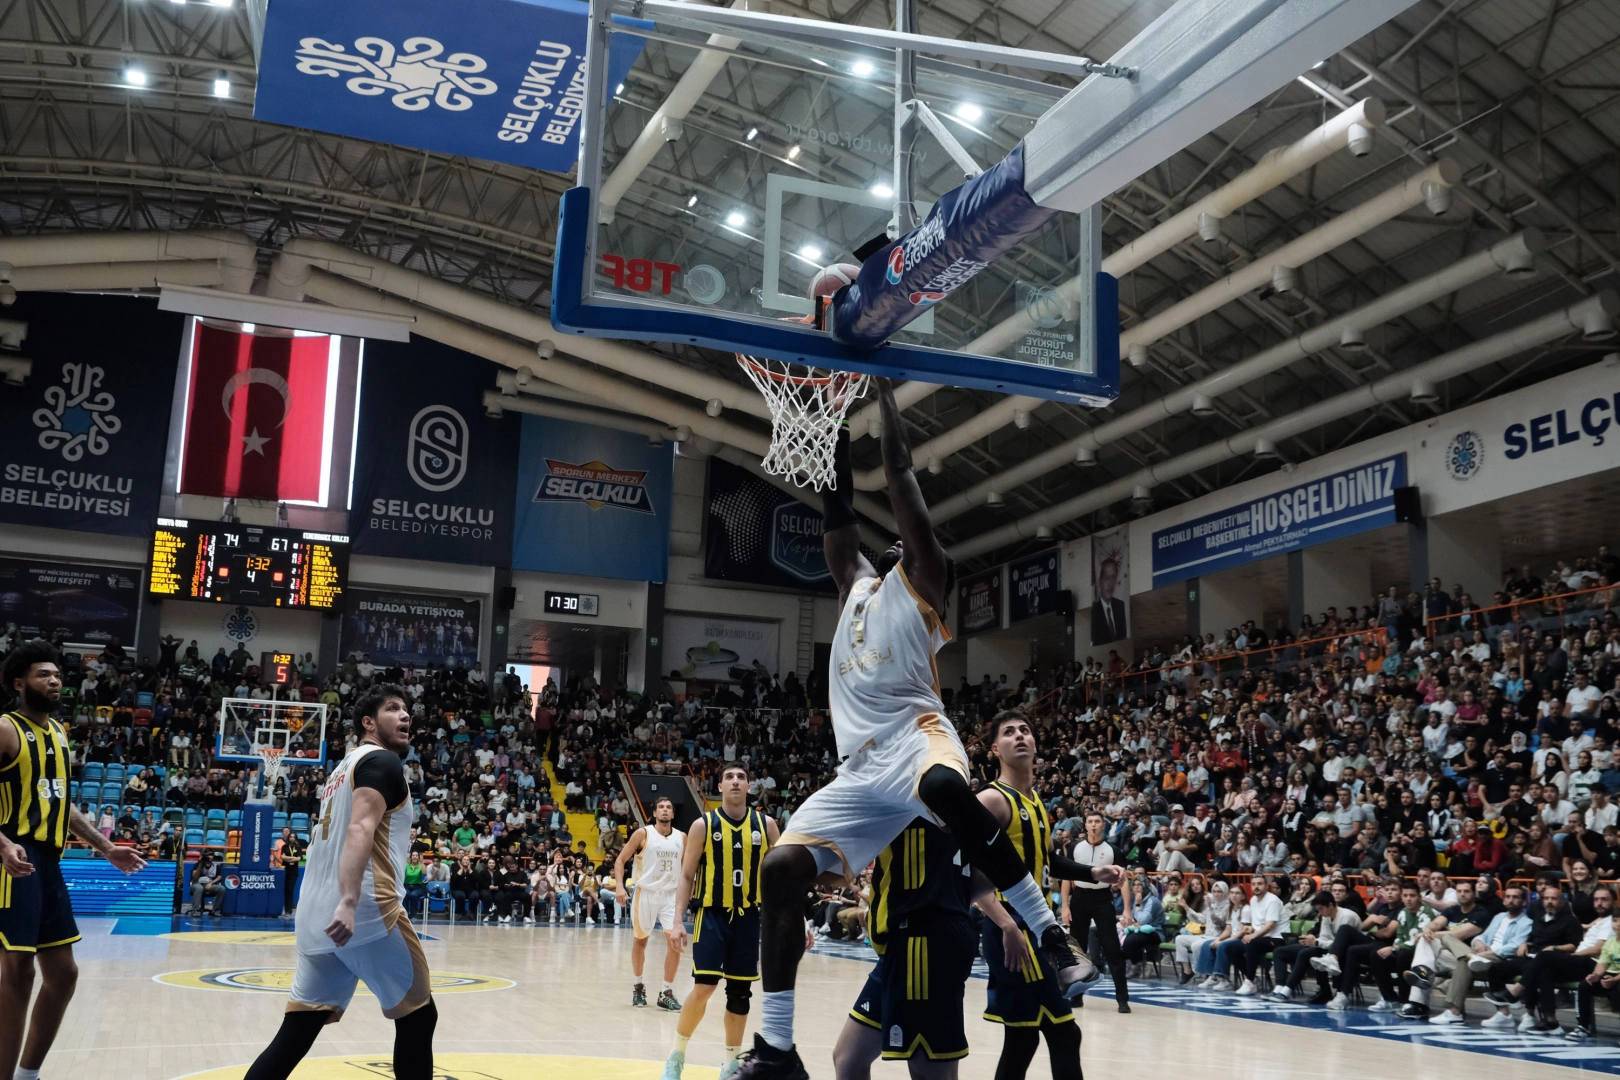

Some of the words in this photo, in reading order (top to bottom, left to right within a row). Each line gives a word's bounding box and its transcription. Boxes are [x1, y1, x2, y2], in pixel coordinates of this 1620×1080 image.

[497, 40, 571, 143] SELÇUKLU
[905, 226, 946, 272] SİGORTA
[4, 463, 133, 495] SELÇUKLU
[552, 466, 594, 479] SPORUN
[545, 477, 642, 505] SELÇUKLU
[1251, 460, 1395, 537] HOŞGELDİNİZ
[1, 487, 130, 517] BELEDİYESİ
[372, 498, 494, 526] SELÇUKLU
[370, 518, 493, 540] BELEDİYESPOR
[224, 533, 239, 546] 74
[271, 538, 288, 551] 67
[1158, 532, 1191, 549] SELÇUKLU
[246, 557, 270, 570] 1:32
[38, 575, 57, 583] ONU
[247, 570, 255, 582] 4
[359, 601, 407, 614] BURADA
[409, 605, 465, 619] YETİŞİYOR
[550, 596, 561, 608] 17
[563, 597, 578, 610] 30
[273, 654, 291, 664] 1:32
[276, 666, 287, 682] 5
[38, 778, 65, 799] 35
[656, 851, 678, 859] KONYA
[660, 859, 673, 872] 33
[733, 869, 744, 887] 0
